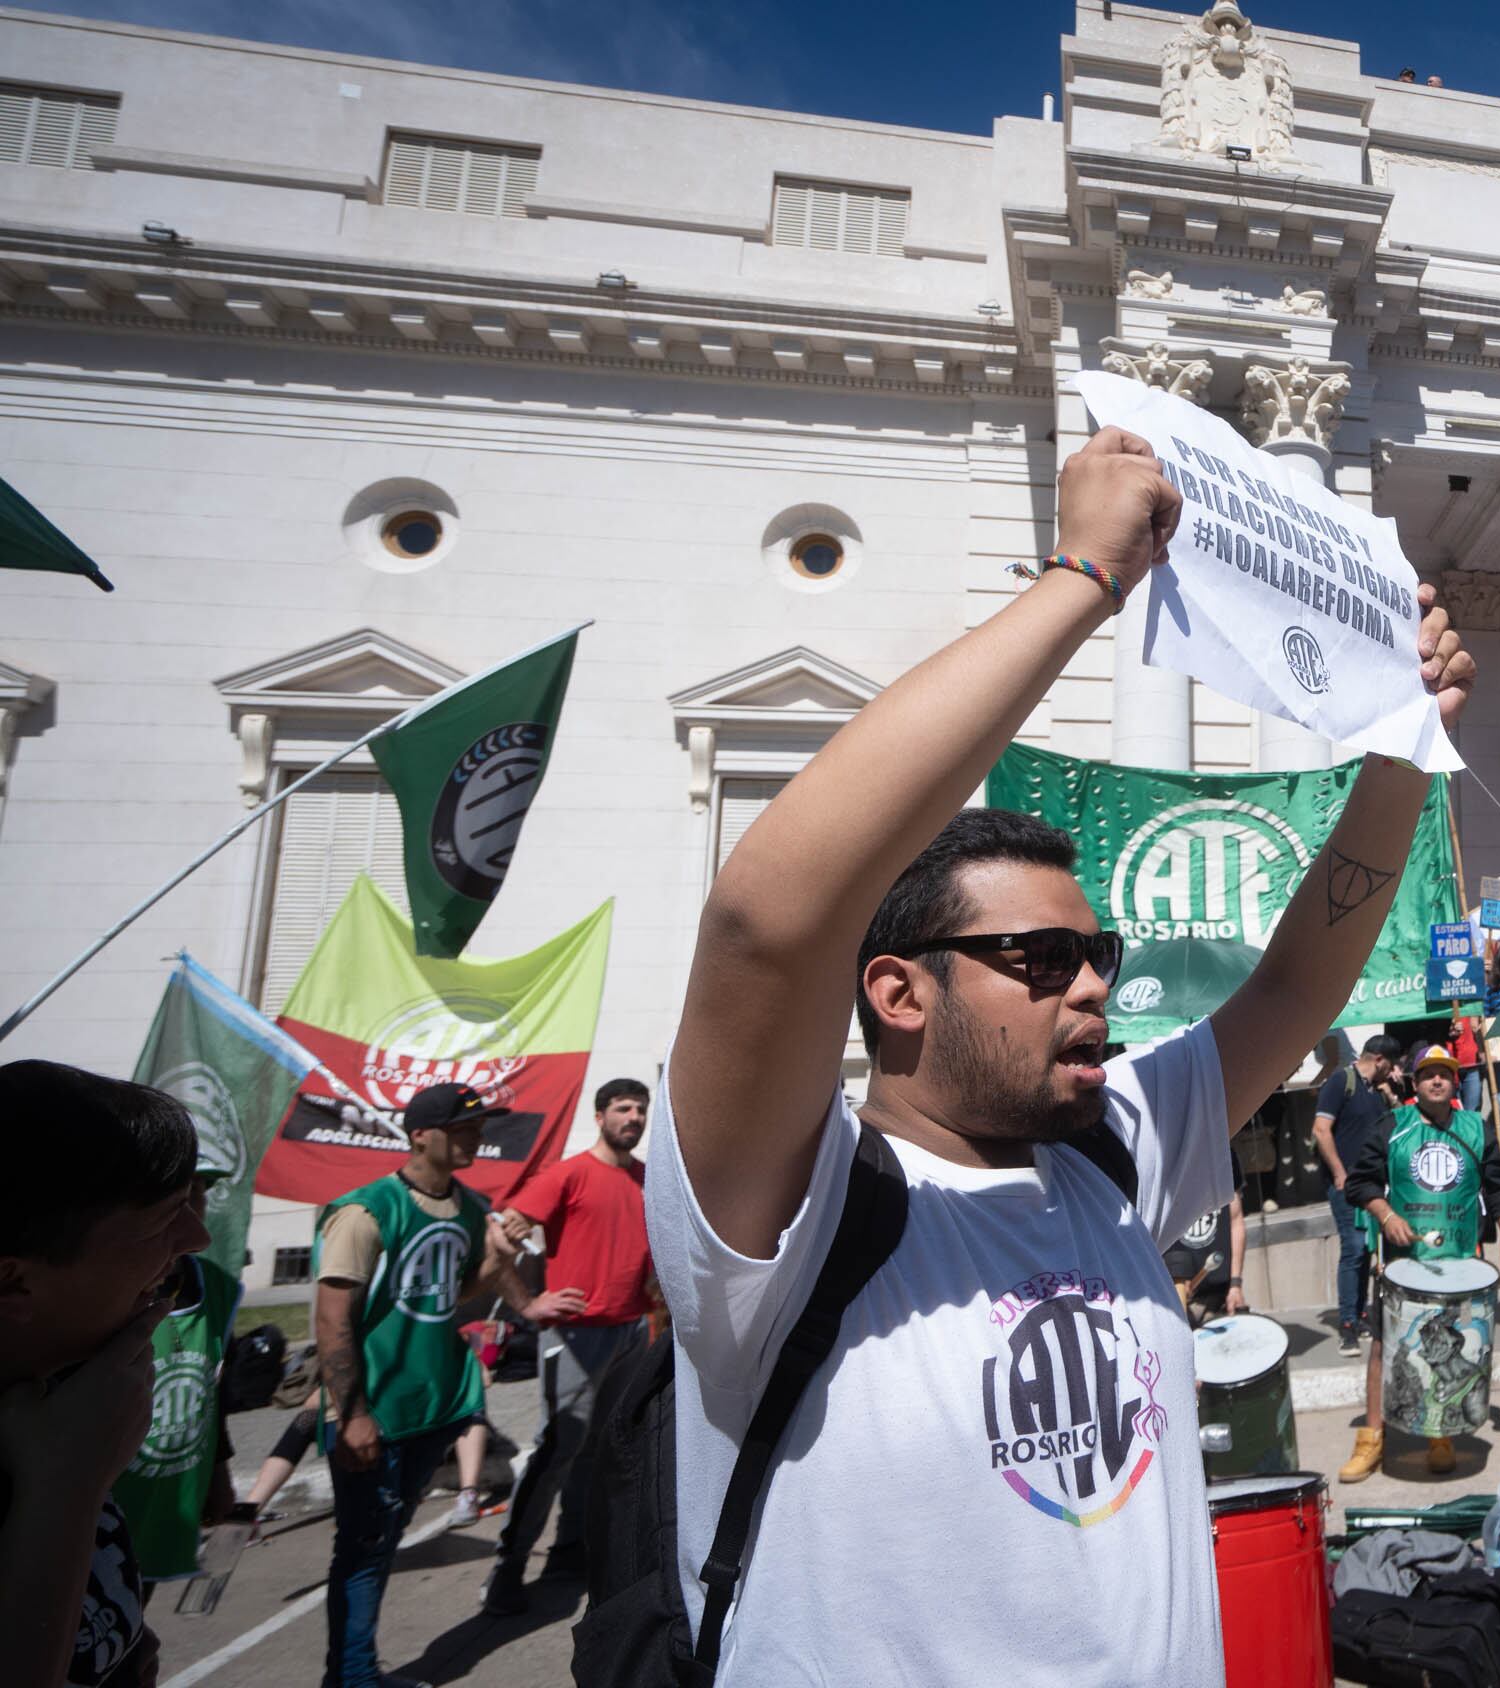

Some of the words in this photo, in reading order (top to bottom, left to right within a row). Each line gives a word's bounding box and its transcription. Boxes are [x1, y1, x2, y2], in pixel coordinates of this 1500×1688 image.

[1158, 456, 1337, 573] UBILACIONES
[1342, 551, 1413, 621] DIGNAS
[1171, 435, 1236, 487] POR
[1237, 469, 1360, 552] SALARIOS
[1358, 536, 1373, 563] Y
[1193, 517, 1396, 650] #NOALAREFORMA
[1118, 919, 1237, 941] ROSARIO
[1134, 820, 1286, 945] ATE
[1437, 938, 1470, 957] PARO
[363, 1065, 453, 1085] ROSARIO
[991, 1424, 1098, 1470] ROSARIO
[1008, 1294, 1142, 1500] ATE
